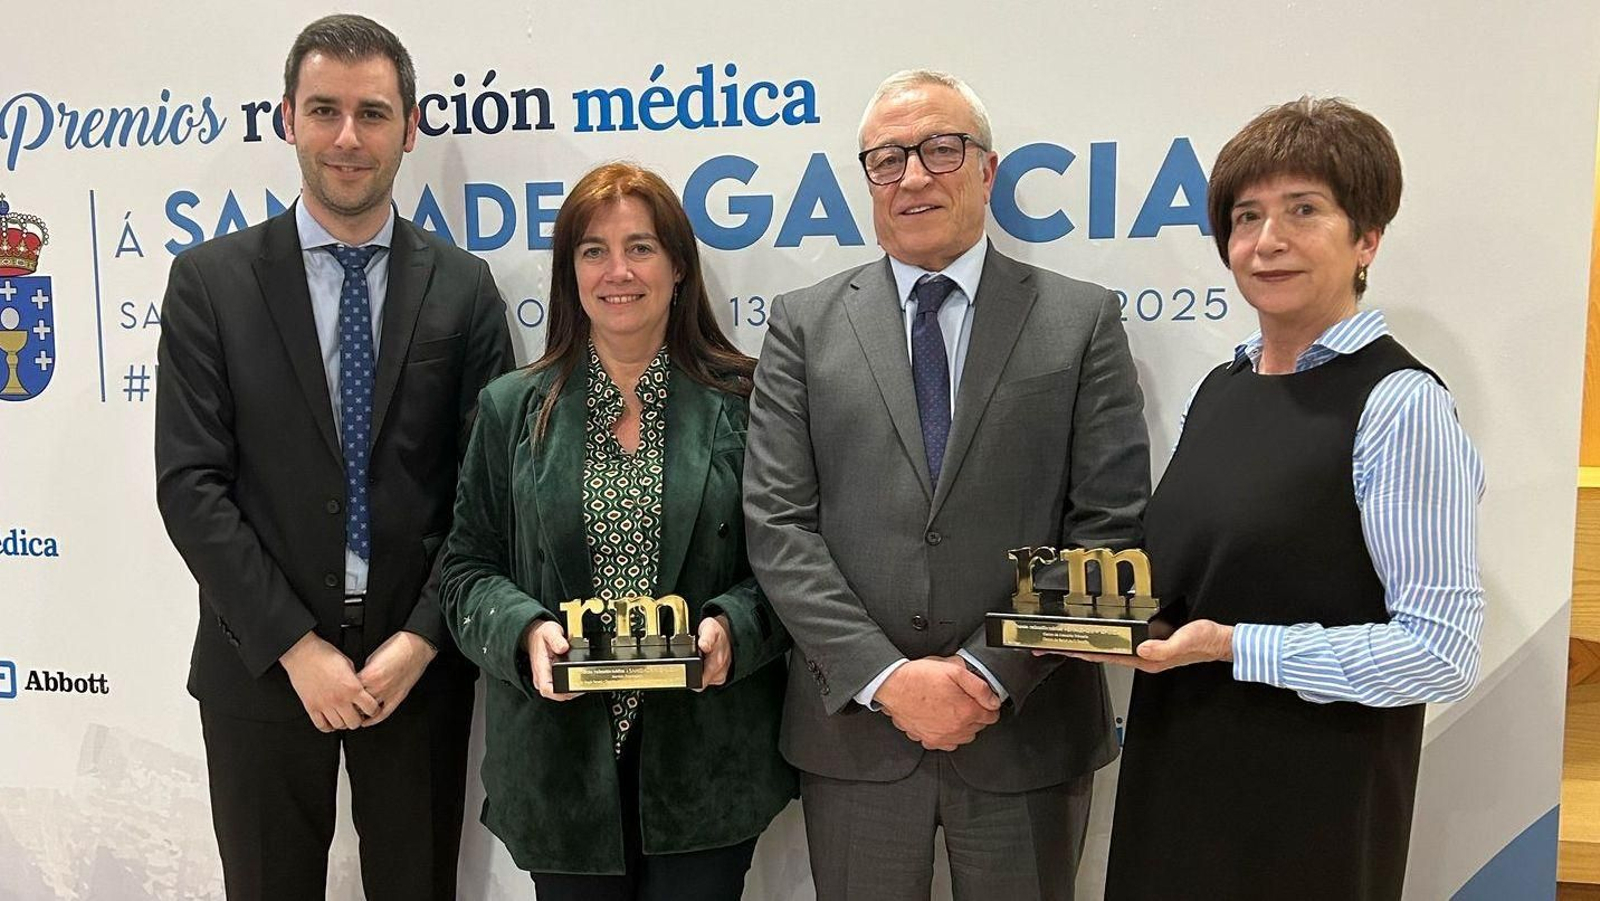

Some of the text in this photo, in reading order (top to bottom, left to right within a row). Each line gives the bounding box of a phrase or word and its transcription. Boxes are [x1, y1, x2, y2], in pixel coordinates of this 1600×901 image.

[0, 63, 820, 171] Premios rción médica
[115, 137, 1215, 258] Á SAADE GACIA
[729, 296, 767, 327] 13
[0, 528, 59, 557] dica
[1008, 546, 1160, 607] rm
[560, 593, 696, 648] rm
[24, 669, 110, 695] Abbott
